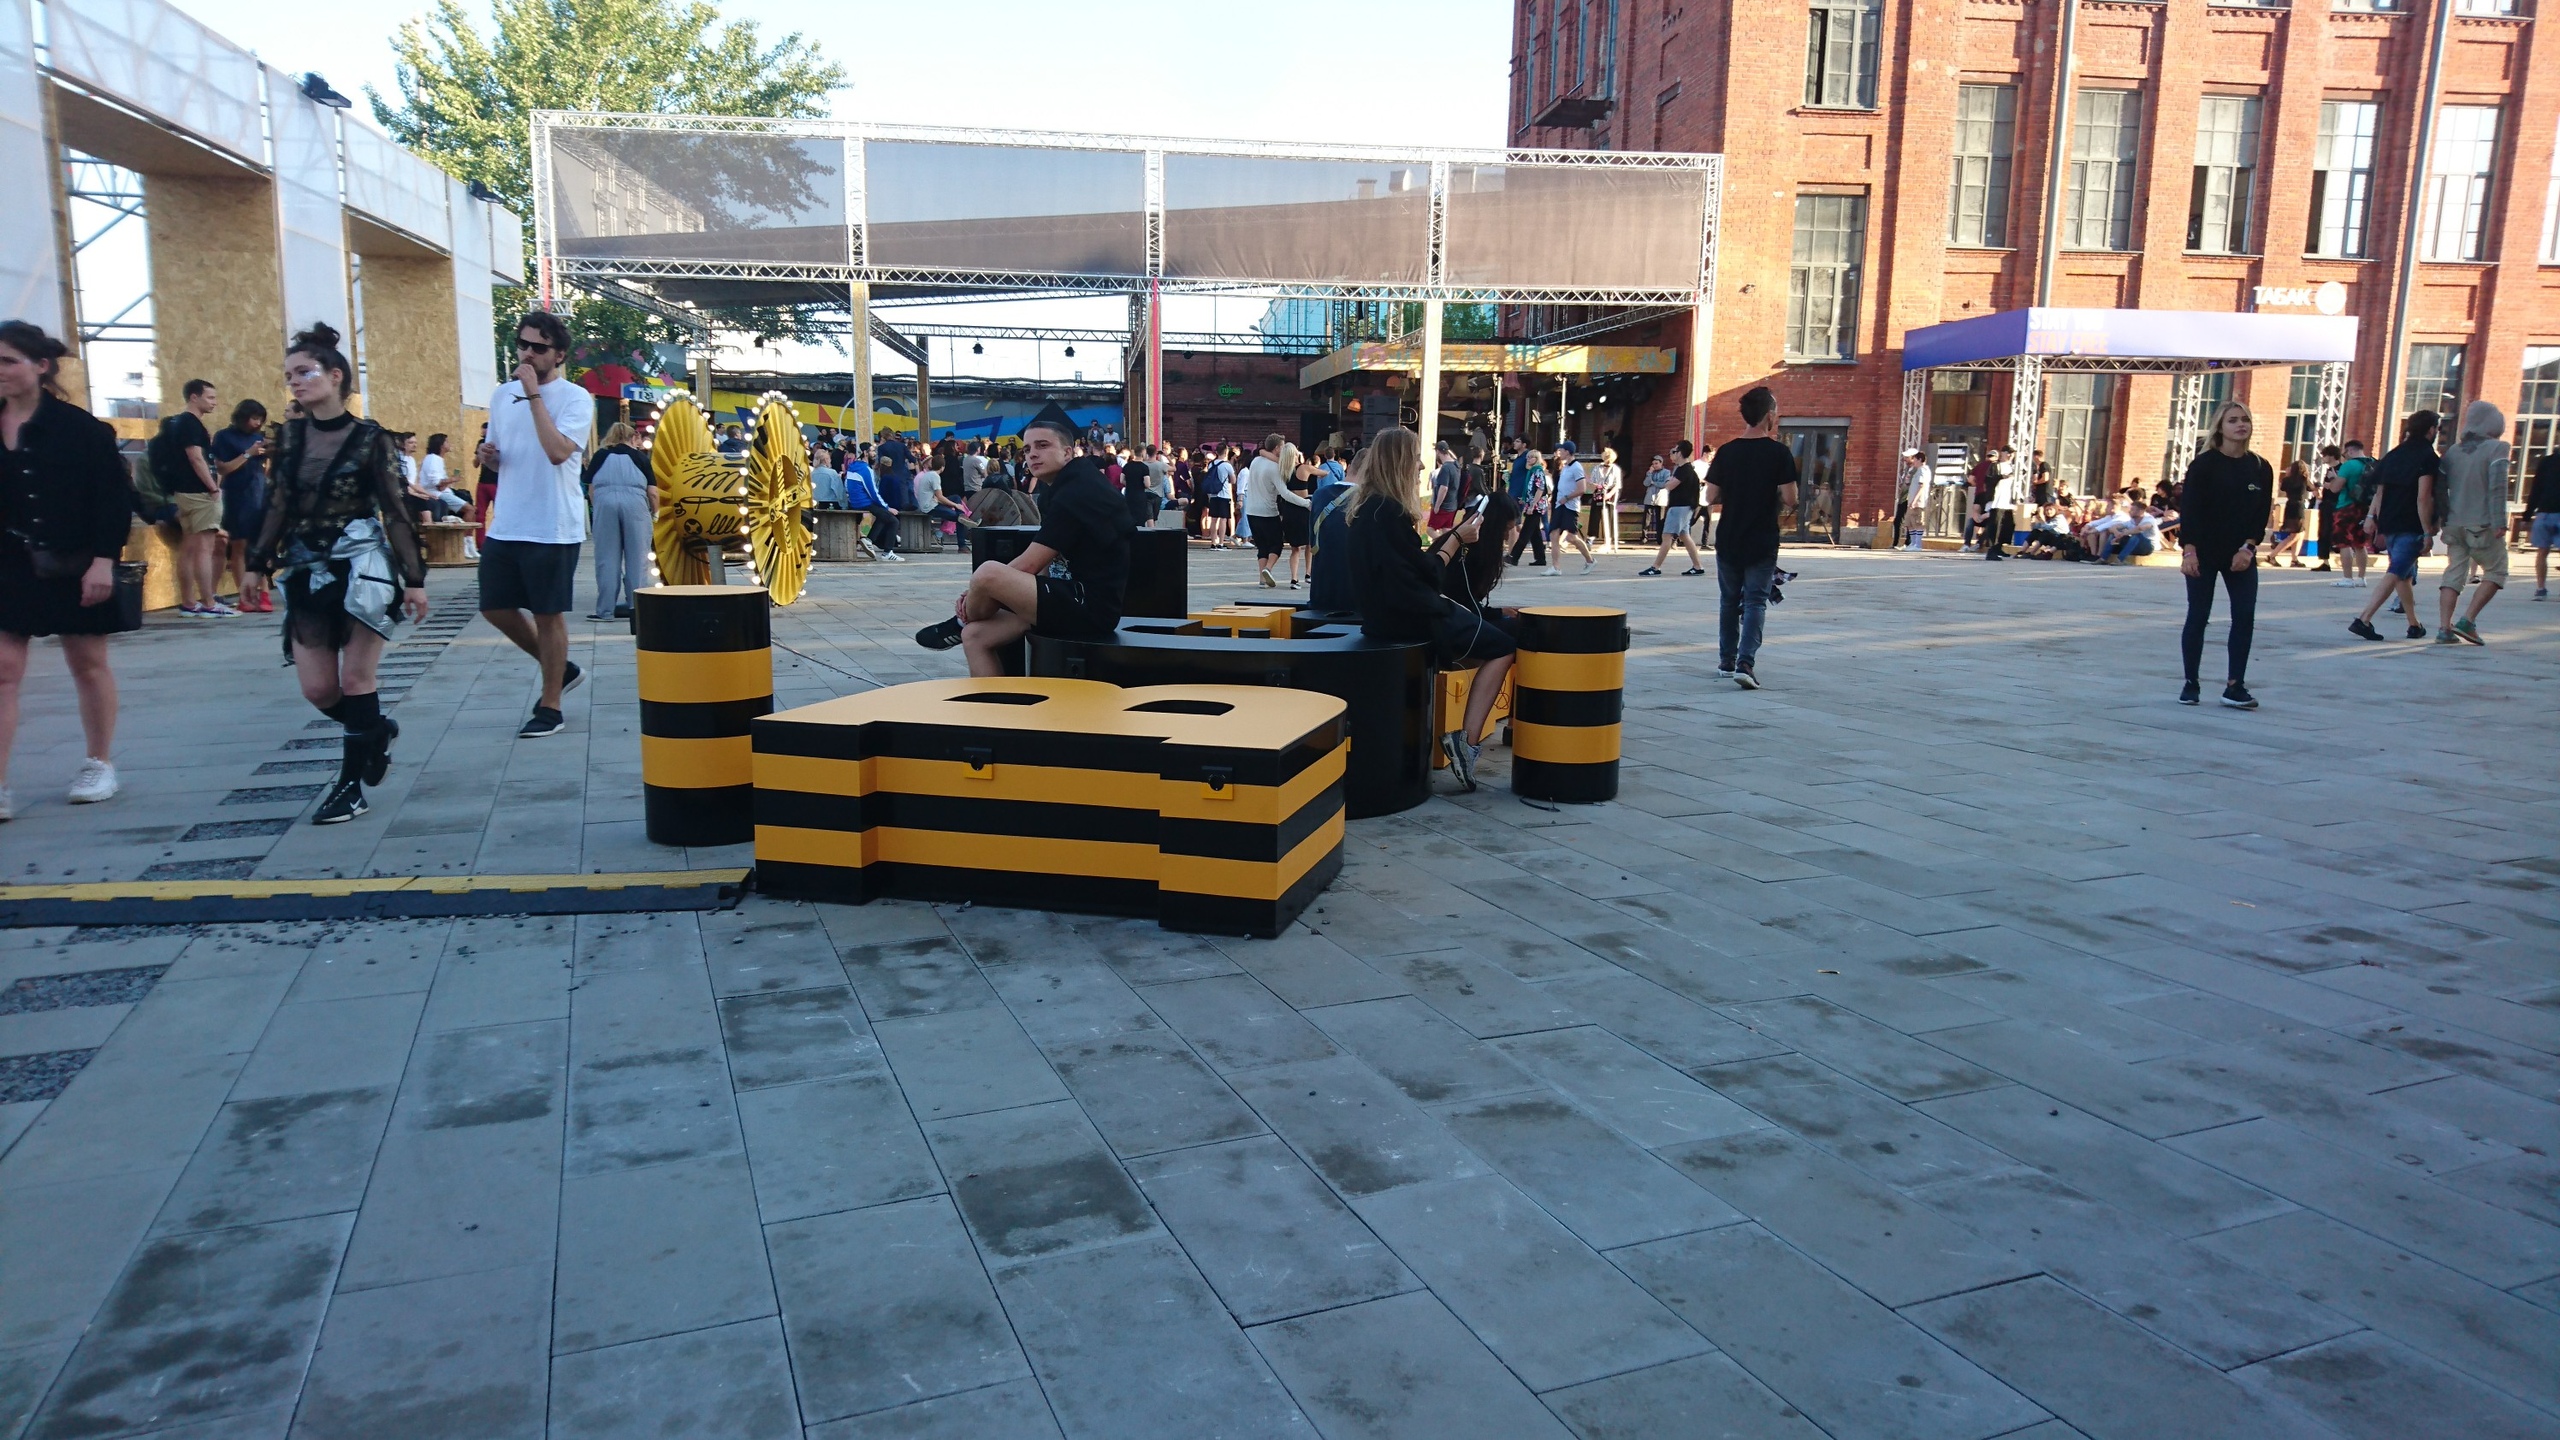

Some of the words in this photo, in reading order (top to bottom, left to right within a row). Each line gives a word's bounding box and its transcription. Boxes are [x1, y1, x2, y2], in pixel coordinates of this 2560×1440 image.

[2253, 286, 2313, 306] ТАБАК
[2029, 309, 2070, 330] STAY
[2026, 331, 2069, 353] STAY
[2071, 332, 2108, 354] FREE
